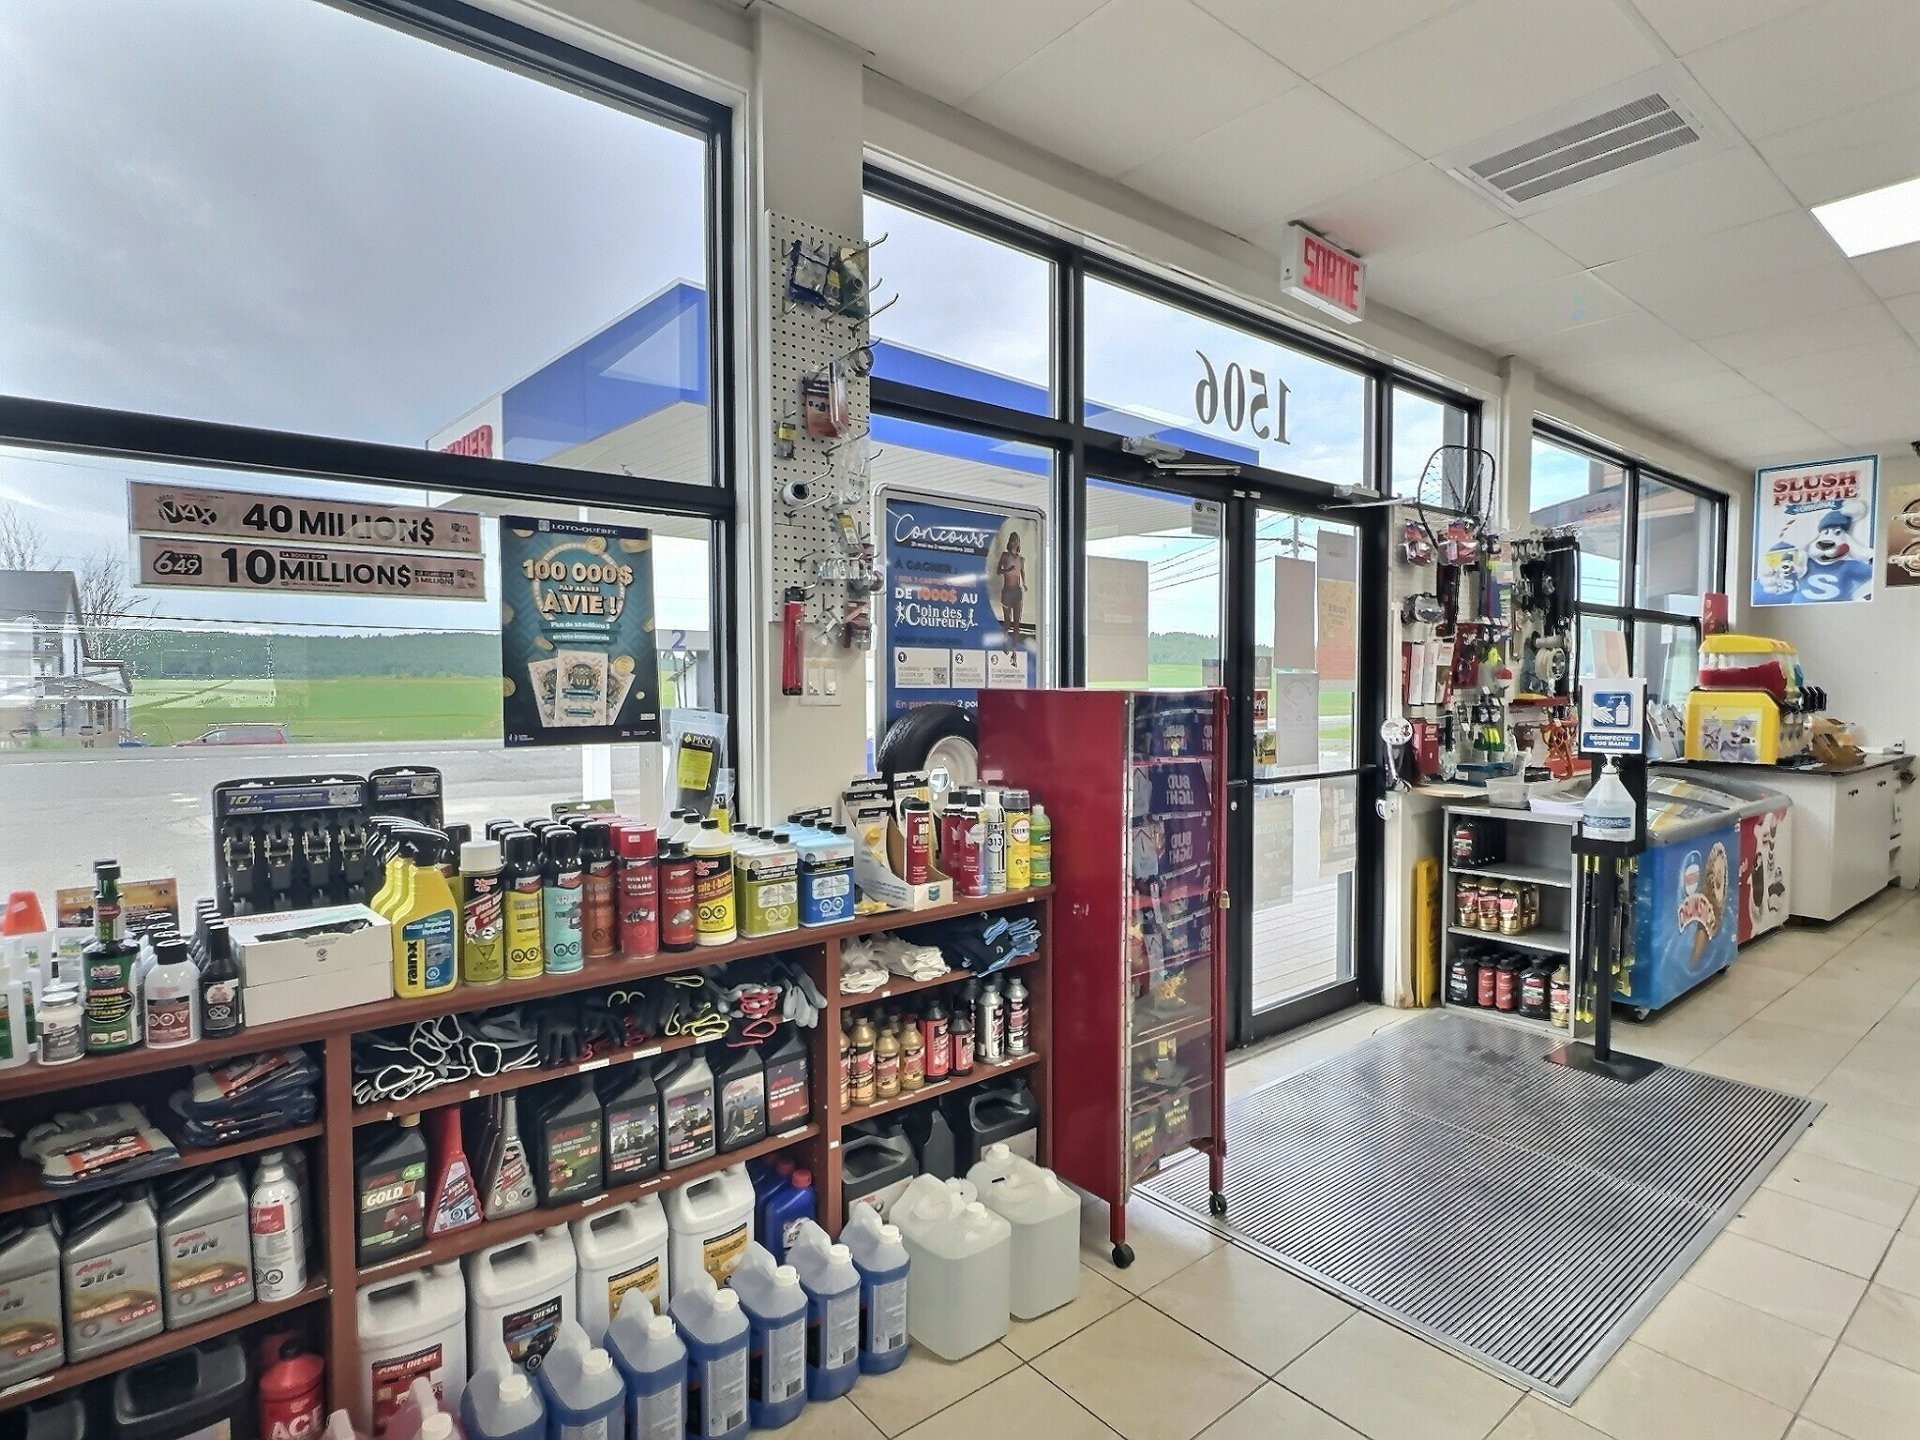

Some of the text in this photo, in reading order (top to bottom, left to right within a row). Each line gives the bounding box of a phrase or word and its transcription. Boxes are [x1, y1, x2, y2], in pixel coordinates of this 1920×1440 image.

[1303, 236, 1360, 312] SORTIE
[1773, 470, 1859, 494] SLUSH
[1773, 487, 1858, 506] PUPPIE
[243, 503, 434, 545] 40 MILLION$
[895, 514, 989, 549] Concours
[221, 548, 276, 584] 10
[279, 560, 412, 588] MILLION$
[523, 559, 634, 586] 100 000$
[895, 587, 913, 599] DE
[961, 592, 978, 605] AU
[1802, 574, 1841, 600] S
[543, 588, 561, 613] À
[563, 594, 604, 614] VIE
[941, 606, 962, 618] des
[671, 630, 687, 649] 2
[957, 700, 964, 708] 2
[1589, 735, 1634, 743] DÉSINFECTEZ
[988, 838, 1002, 847] 313
[366, 1186, 403, 1207] GOLD
[532, 1303, 559, 1322] DIESEL
[406, 1352, 438, 1369] DIESEL
